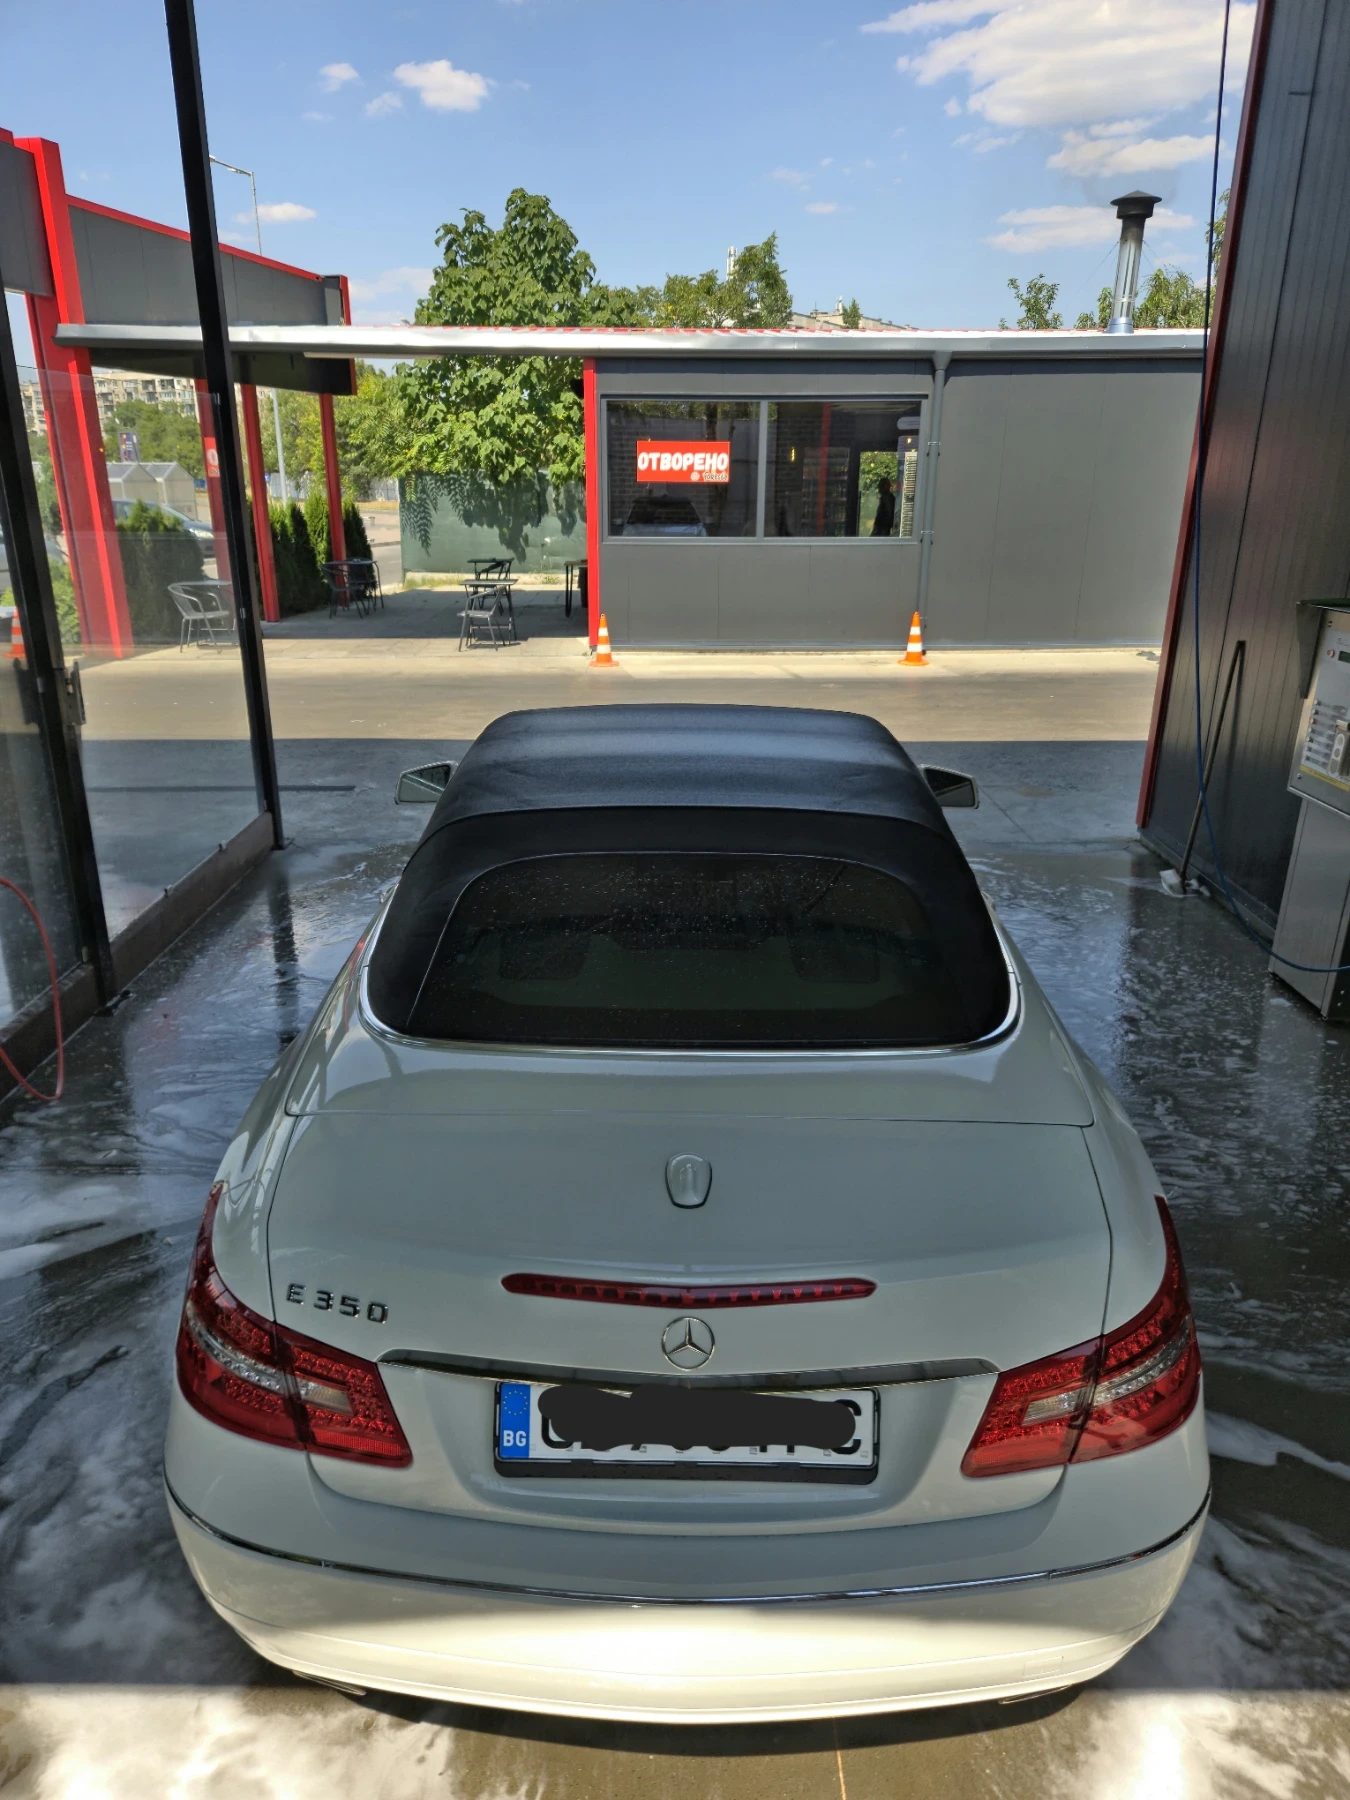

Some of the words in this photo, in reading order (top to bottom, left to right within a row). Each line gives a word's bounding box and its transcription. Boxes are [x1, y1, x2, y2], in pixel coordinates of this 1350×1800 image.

[637, 452, 728, 471] ОТВОРЕНО
[286, 1283, 308, 1305] E
[313, 1289, 389, 1324] 350
[503, 1429, 527, 1447] BG
